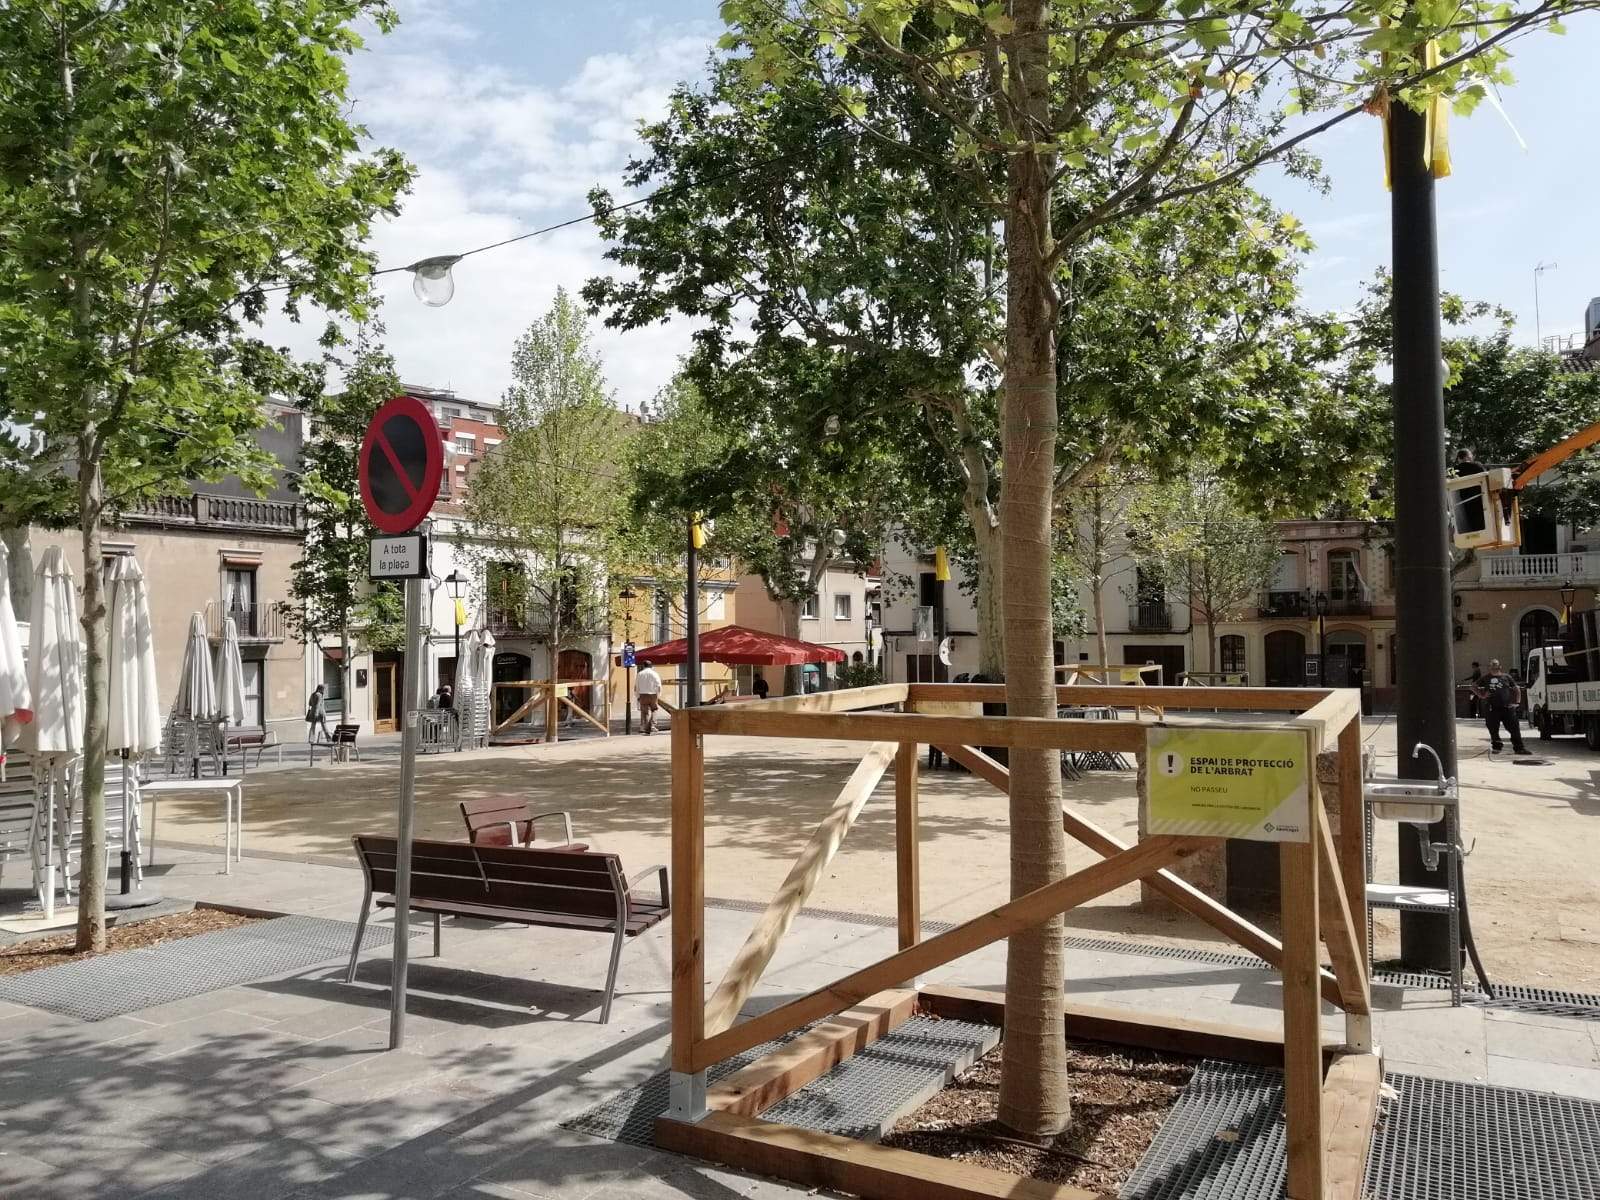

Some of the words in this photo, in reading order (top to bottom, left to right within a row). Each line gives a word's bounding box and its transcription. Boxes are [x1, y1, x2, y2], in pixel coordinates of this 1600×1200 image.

[383, 544, 389, 555] A
[391, 544, 406, 554] tota
[380, 560, 387, 570] la
[389, 559, 409, 571] plaça
[1190, 757, 1218, 766] ESPAI
[1235, 759, 1294, 768] PROTECCIÓ
[1190, 766, 1203, 774] DE
[1205, 767, 1254, 776] L'ARBRAT
[1201, 786, 1228, 794] PASSEU
